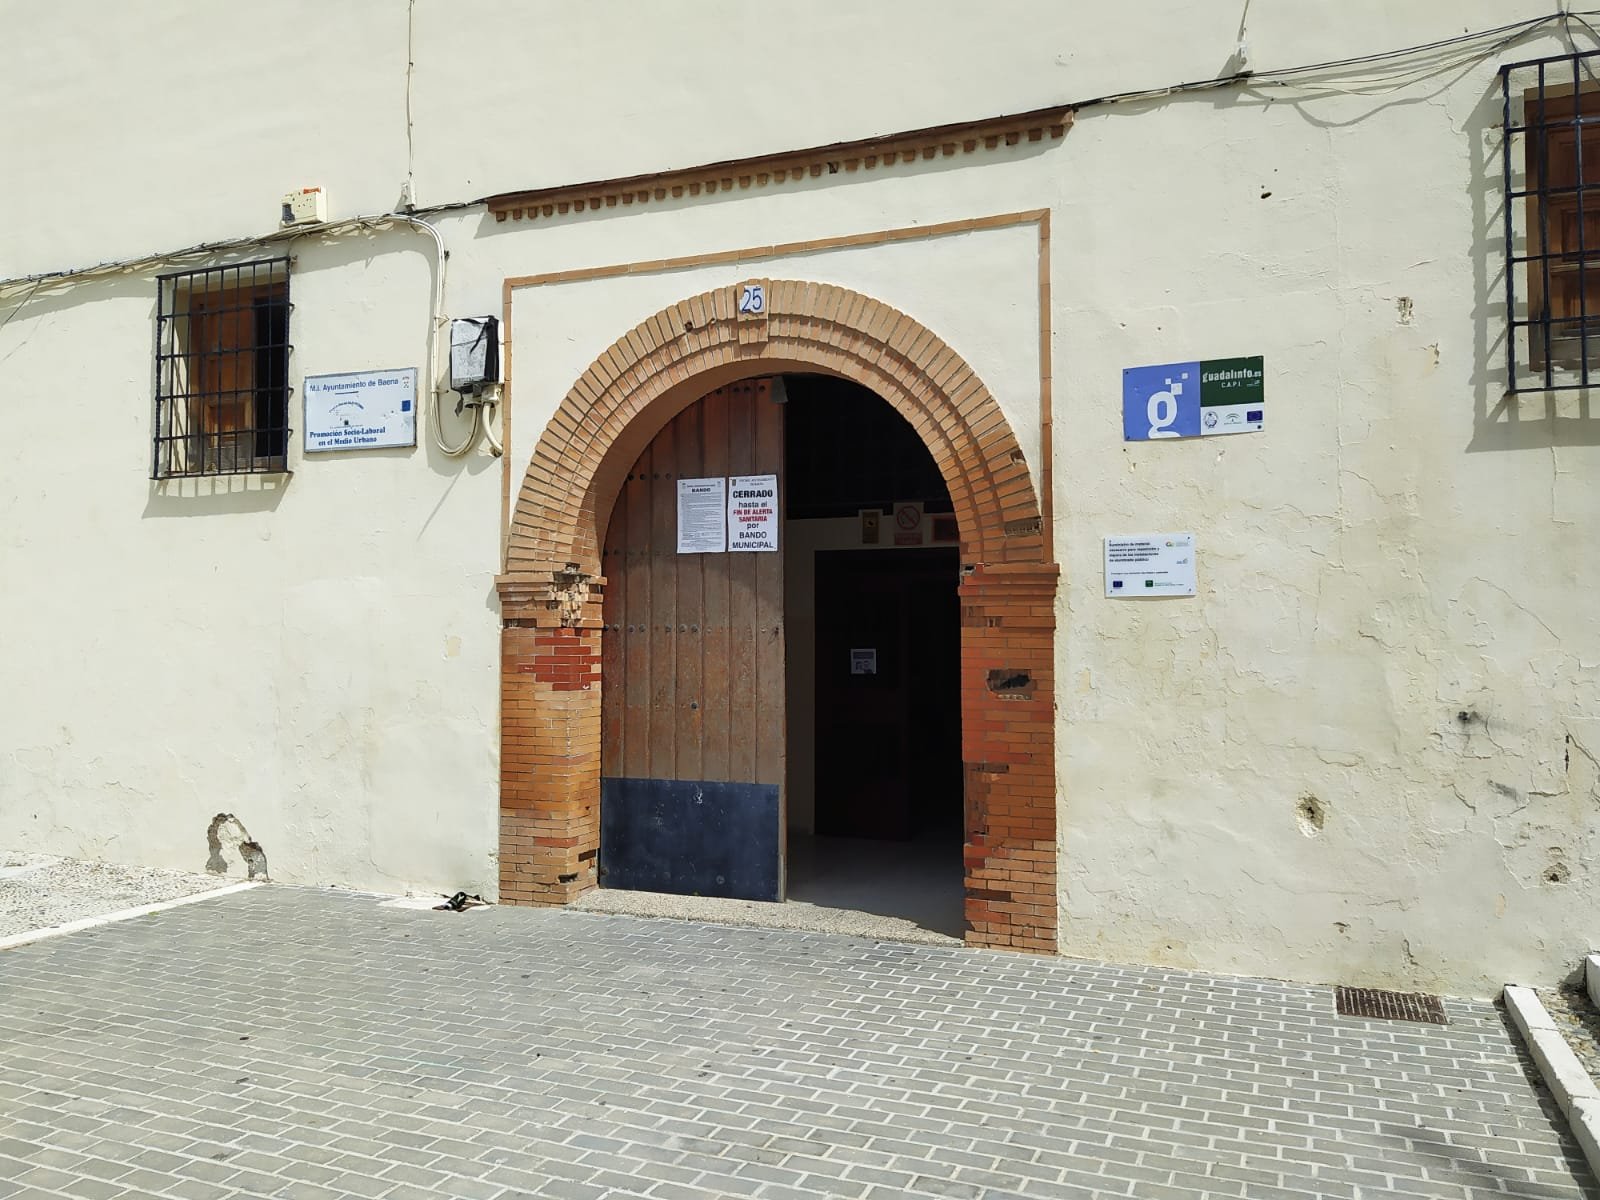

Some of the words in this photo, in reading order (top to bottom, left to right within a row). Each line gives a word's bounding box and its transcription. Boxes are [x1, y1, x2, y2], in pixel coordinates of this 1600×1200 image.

[742, 288, 762, 312] 25
[323, 381, 367, 392] Ayuntamiento
[378, 378, 399, 386] Baena
[309, 430, 342, 438] Promoción
[344, 426, 386, 436] Socio-Laboral
[334, 437, 352, 445] Medio
[353, 436, 377, 444] Urbano
[732, 489, 773, 498] CERRADO
[739, 531, 767, 539] BANDO
[732, 541, 774, 549] MUNICIPAL
